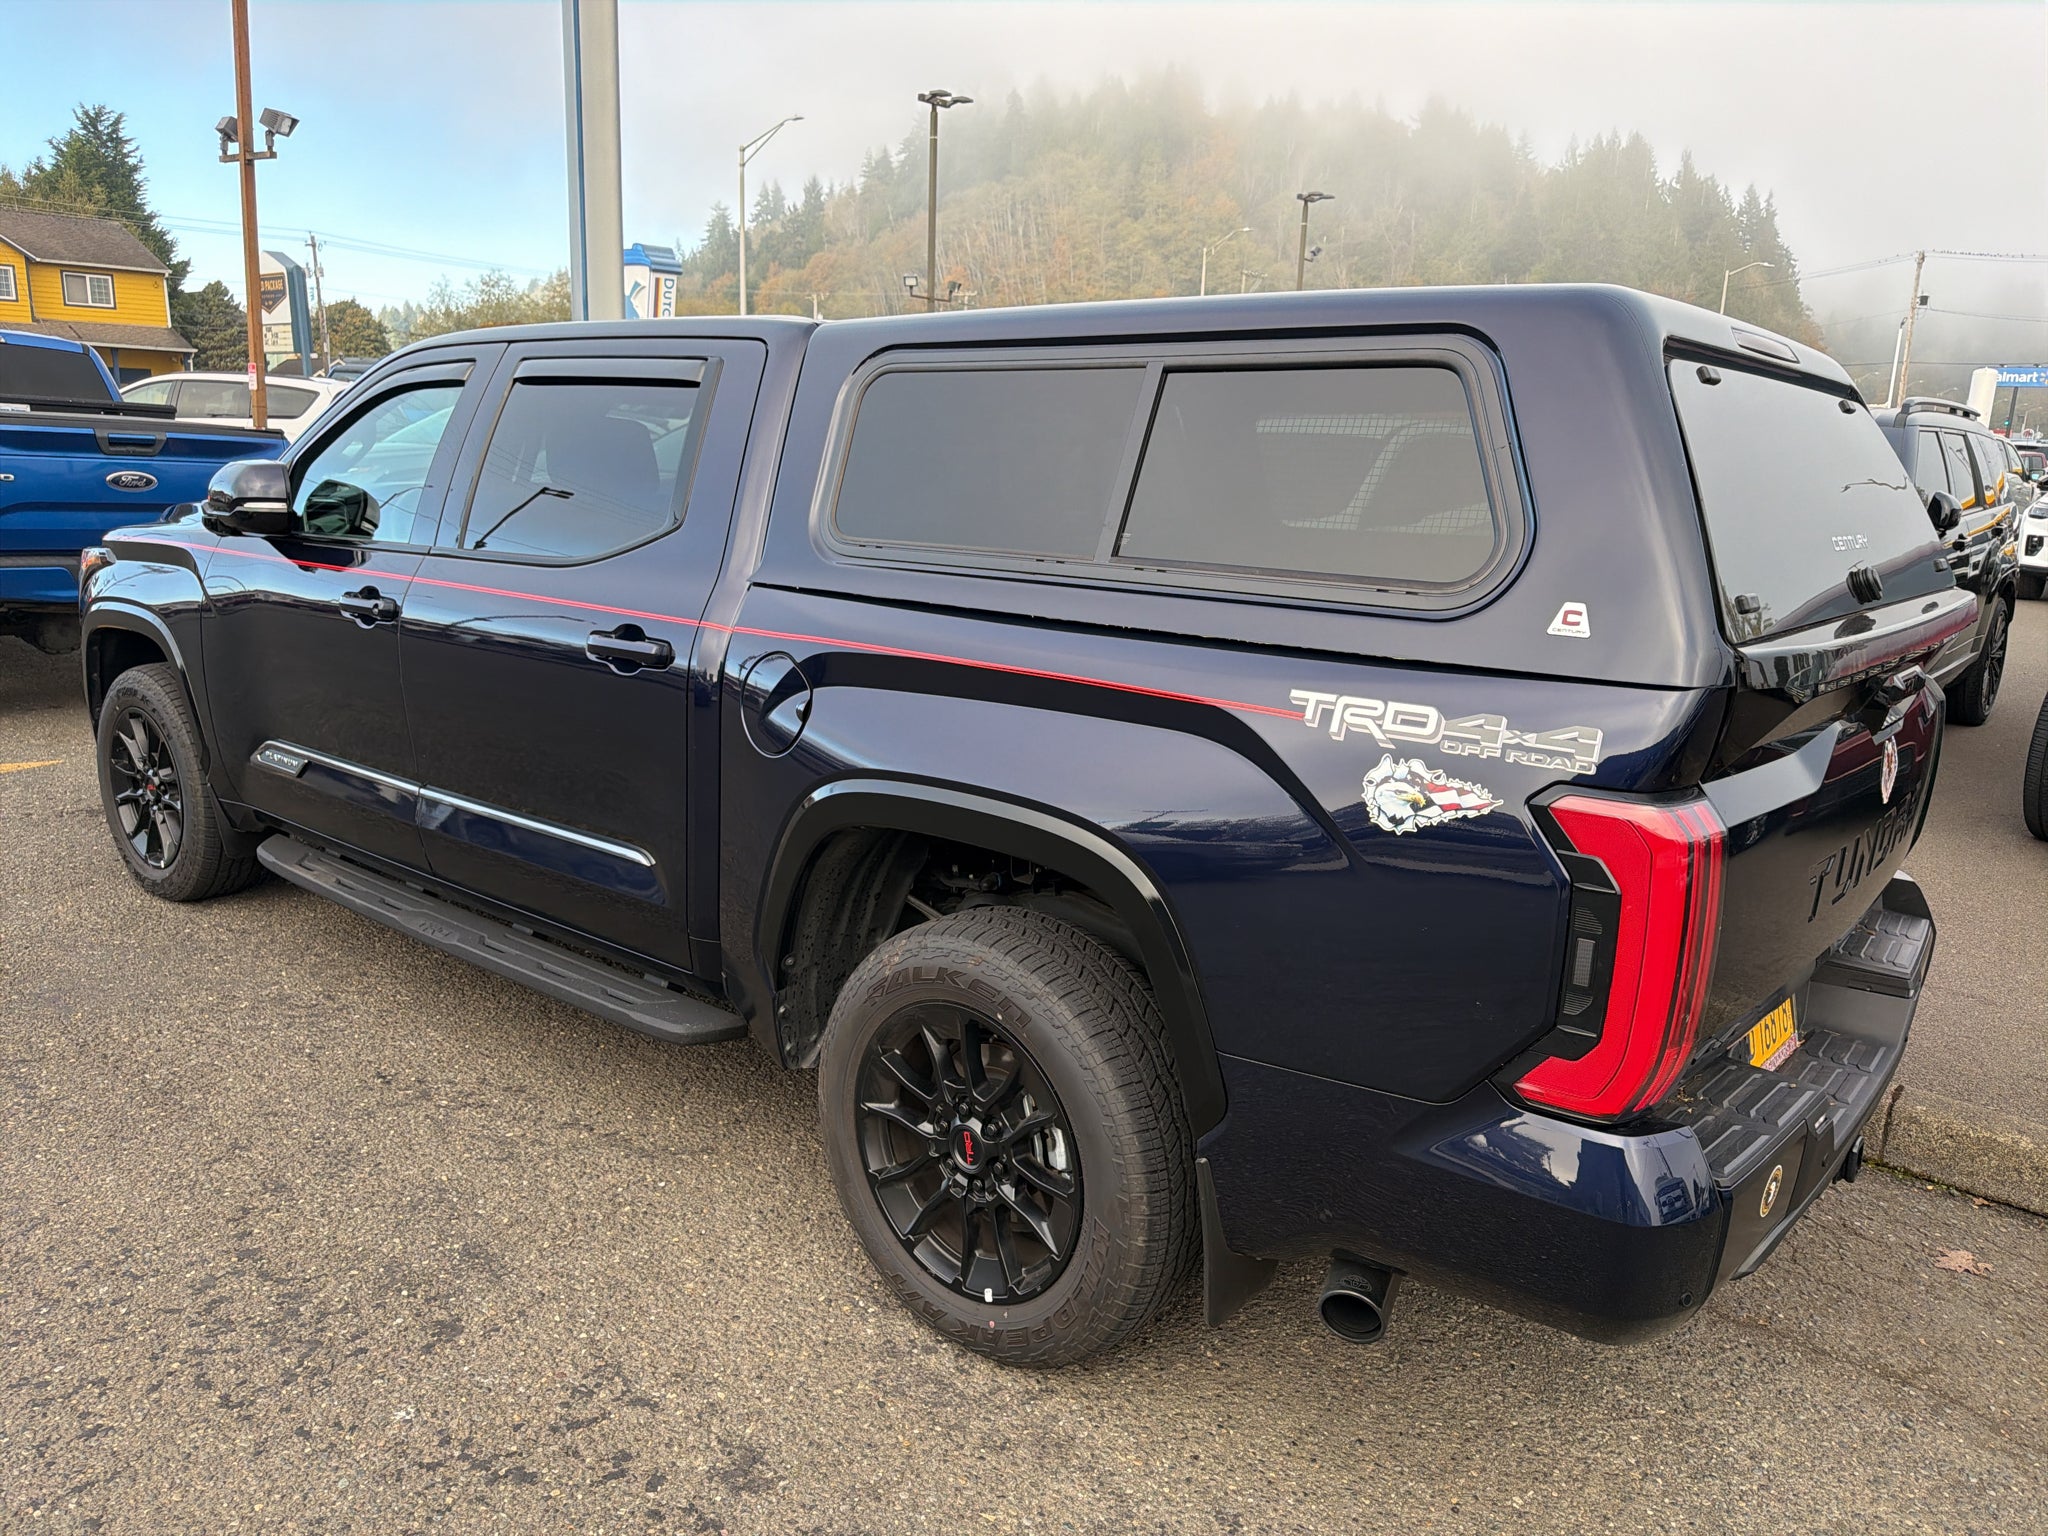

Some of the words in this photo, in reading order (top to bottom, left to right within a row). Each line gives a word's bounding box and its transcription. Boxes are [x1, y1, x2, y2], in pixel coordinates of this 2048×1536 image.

[662, 278, 675, 317] DUTC
[1997, 371, 2039, 383] almart
[119, 475, 146, 488] Ford
[1831, 535, 1868, 551] CENTURY
[1289, 689, 1445, 749] TRD
[1439, 738, 1501, 759] OFF
[1504, 748, 1597, 776] ROAD
